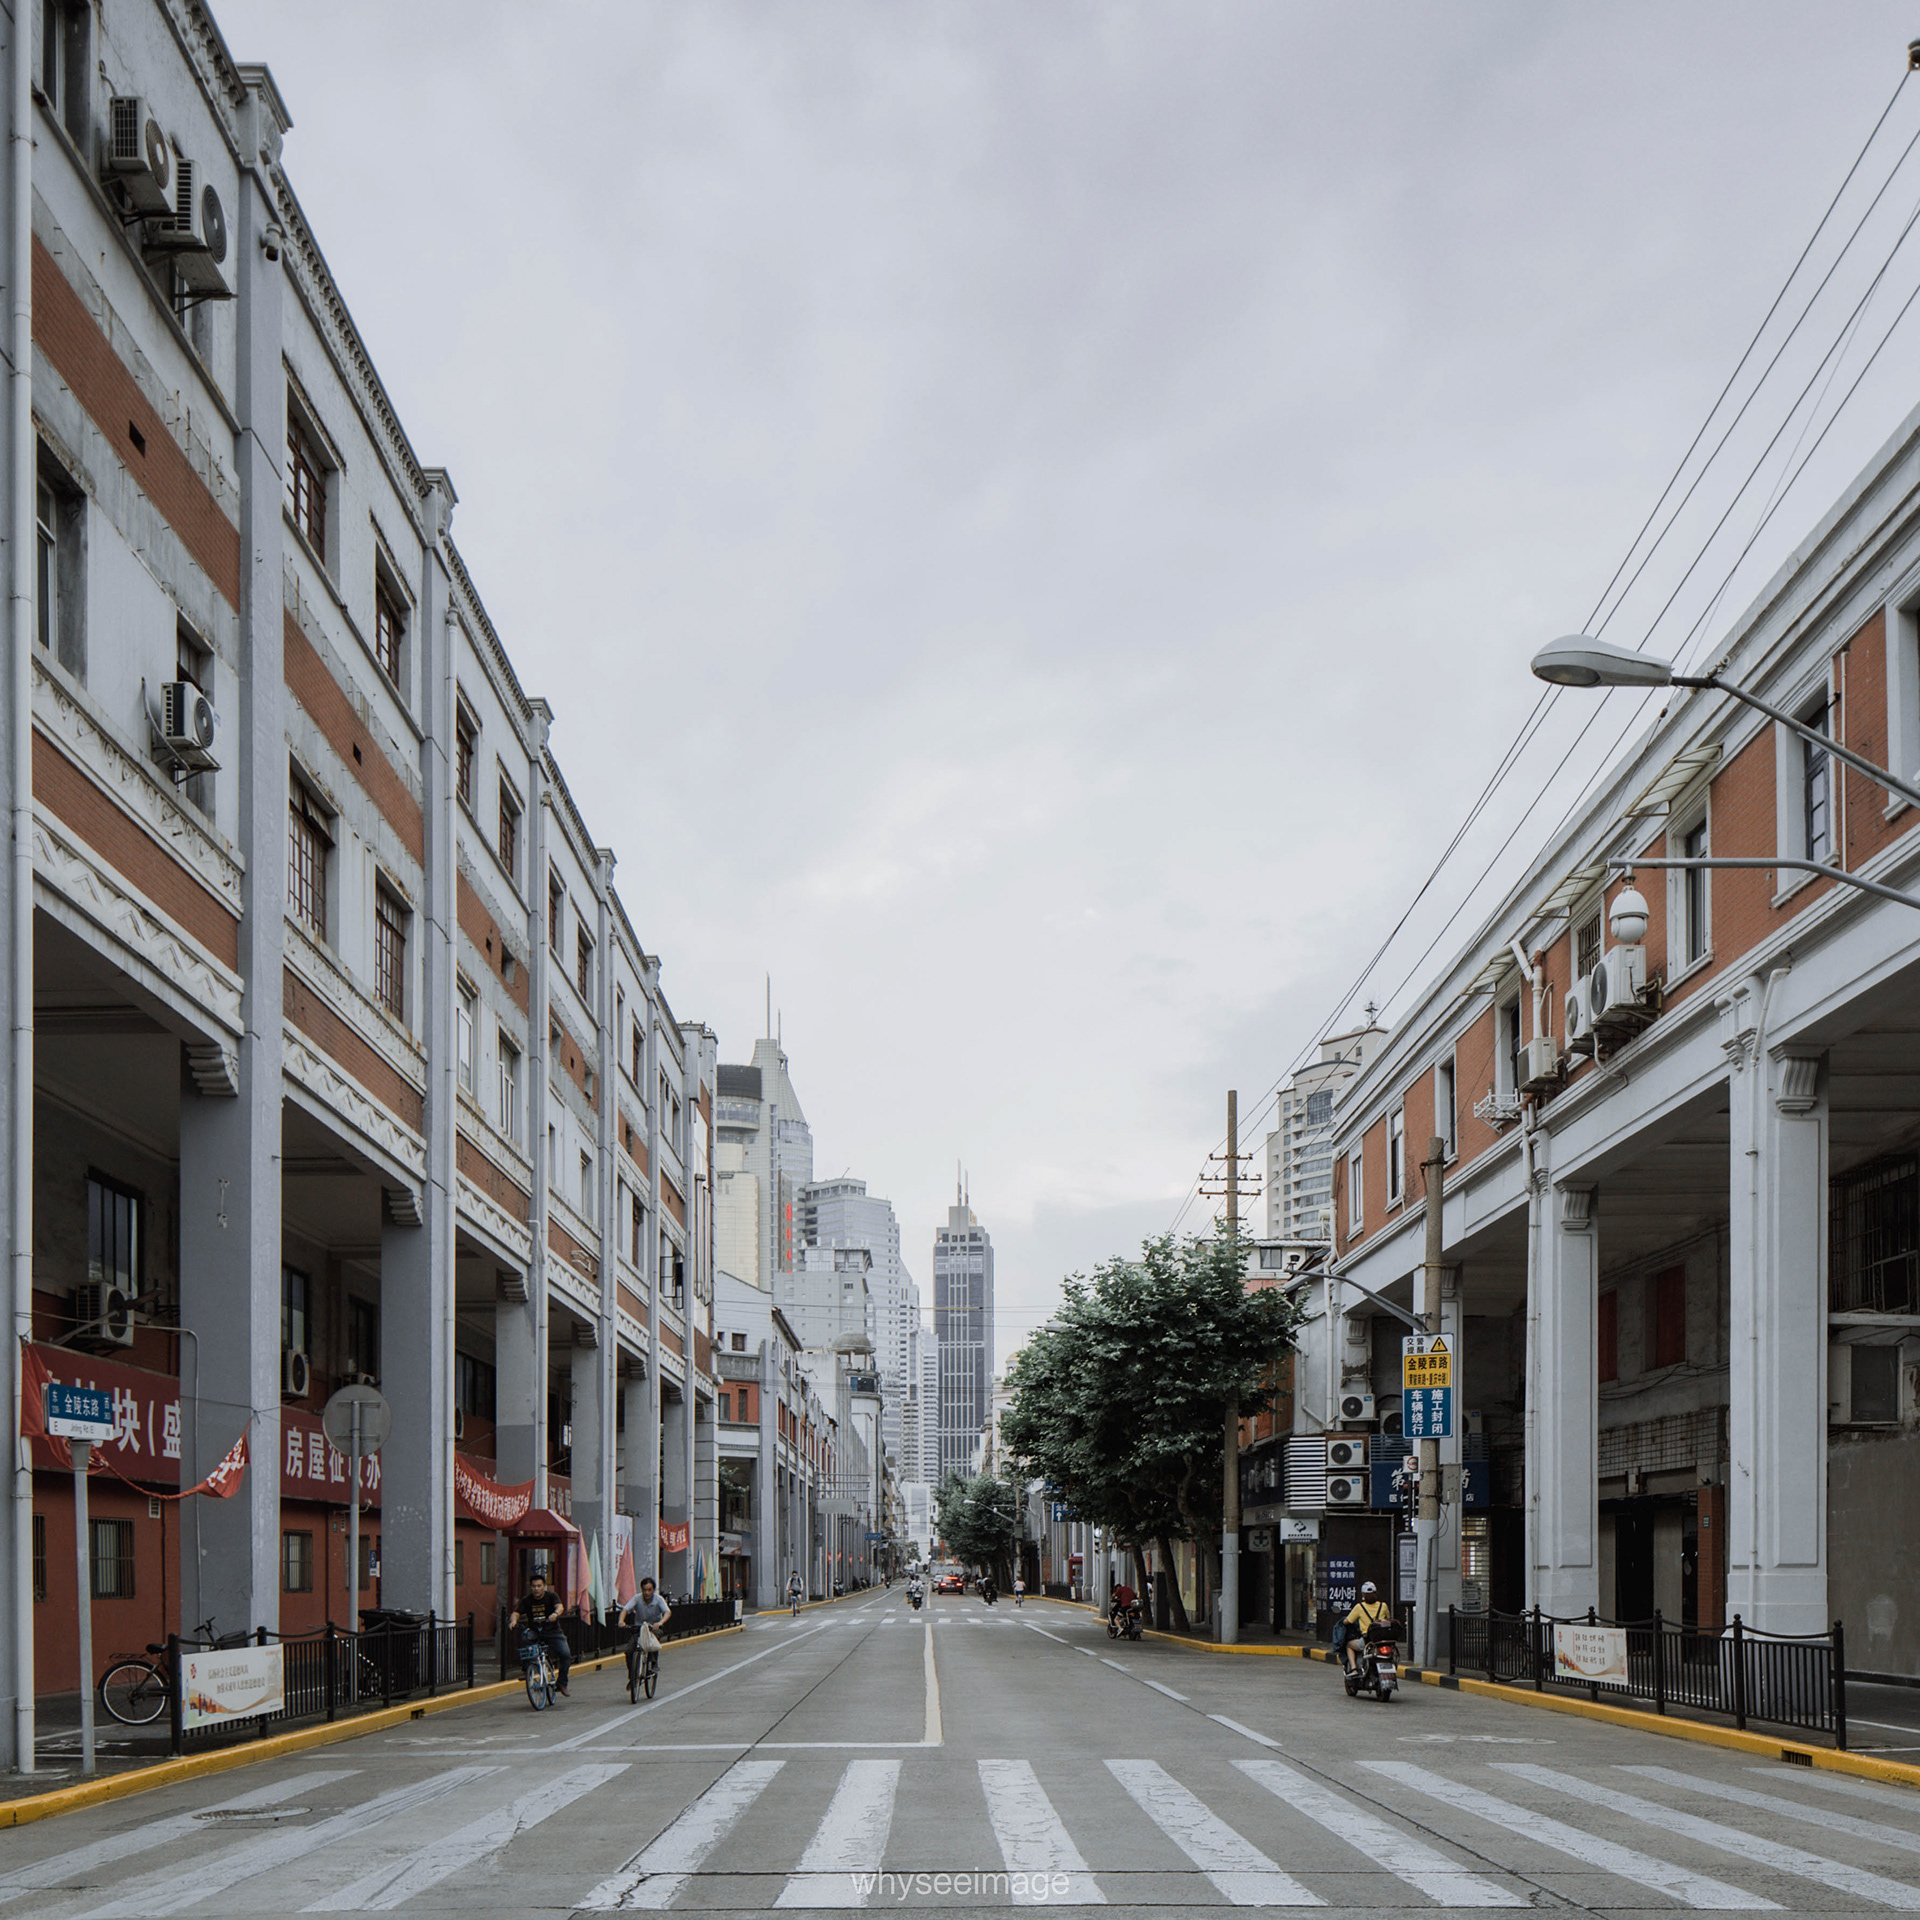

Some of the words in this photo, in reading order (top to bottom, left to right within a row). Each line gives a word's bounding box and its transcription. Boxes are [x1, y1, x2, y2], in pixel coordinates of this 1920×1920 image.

[1407, 1338, 1424, 1346] 交警
[1408, 1356, 1448, 1371] 金陵西路
[64, 1394, 99, 1416] 金陵东路
[1411, 1389, 1424, 1435] 车辆绕行
[1431, 1389, 1444, 1435] 施工封闭
[1329, 1586, 1356, 1601] 24小时
